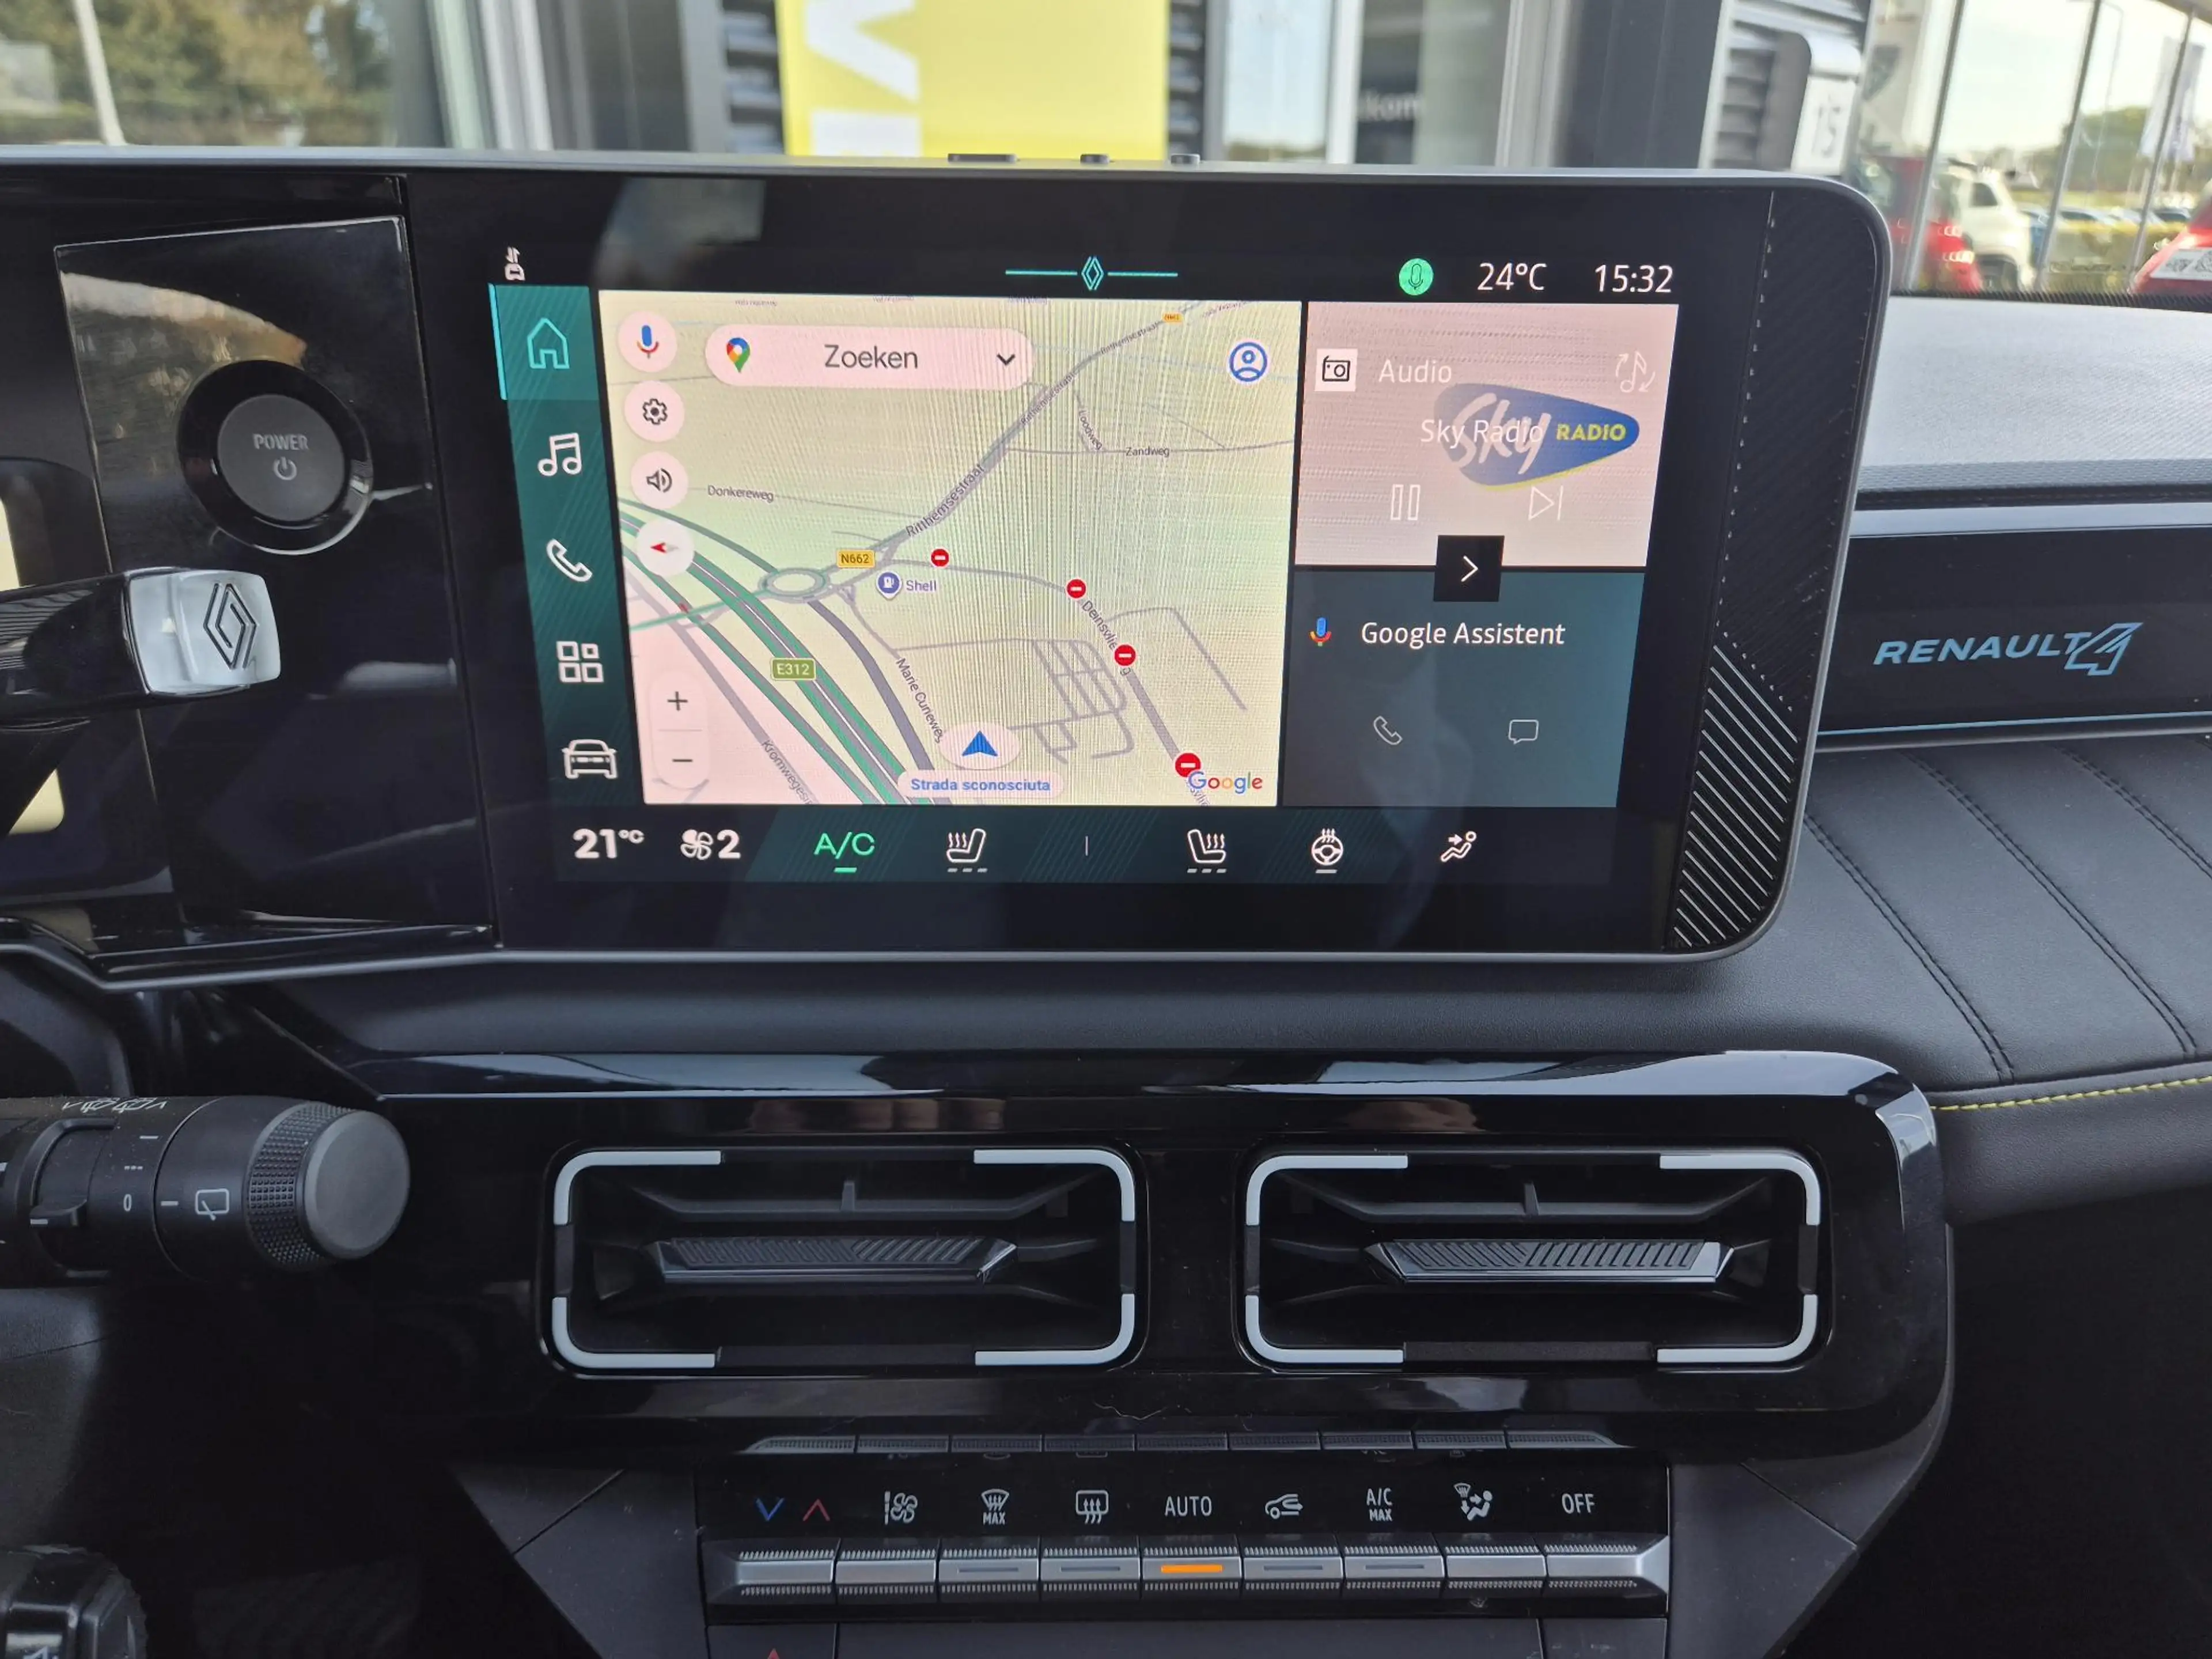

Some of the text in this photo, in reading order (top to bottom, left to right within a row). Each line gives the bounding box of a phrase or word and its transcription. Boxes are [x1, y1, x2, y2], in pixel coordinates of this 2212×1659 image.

[1477, 262, 1547, 291] 24°C
[1594, 264, 1673, 293] 15:32
[824, 343, 918, 369] Zoeken
[1378, 359, 1452, 383] Audio
[253, 433, 309, 450] POWER
[1421, 420, 1543, 448] Sky Radio
[1555, 423, 1627, 441] RADIO
[1125, 446, 1170, 458] Zandweg
[707, 485, 774, 502] Donkereweg
[906, 463, 985, 537] Ritthemsestraat
[840, 553, 870, 565] N662
[906, 579, 937, 593] Shell
[1361, 622, 1566, 649] Google Assistent
[1873, 632, 2092, 666] RENAULT
[776, 663, 810, 676] E312
[895, 657, 919, 692] Marie
[911, 778, 1051, 791] Strada sconosciuta
[1188, 771, 1263, 794] Google
[573, 828, 645, 859] 21°C
[717, 830, 741, 859] 2
[813, 832, 876, 859] A/C
[1164, 1495, 1213, 1518] AUTO
[1366, 1488, 1393, 1507] A/C
[1561, 1493, 1595, 1514] OFF
[982, 1512, 1006, 1525] MAX
[1369, 1508, 1392, 1522] MAX
